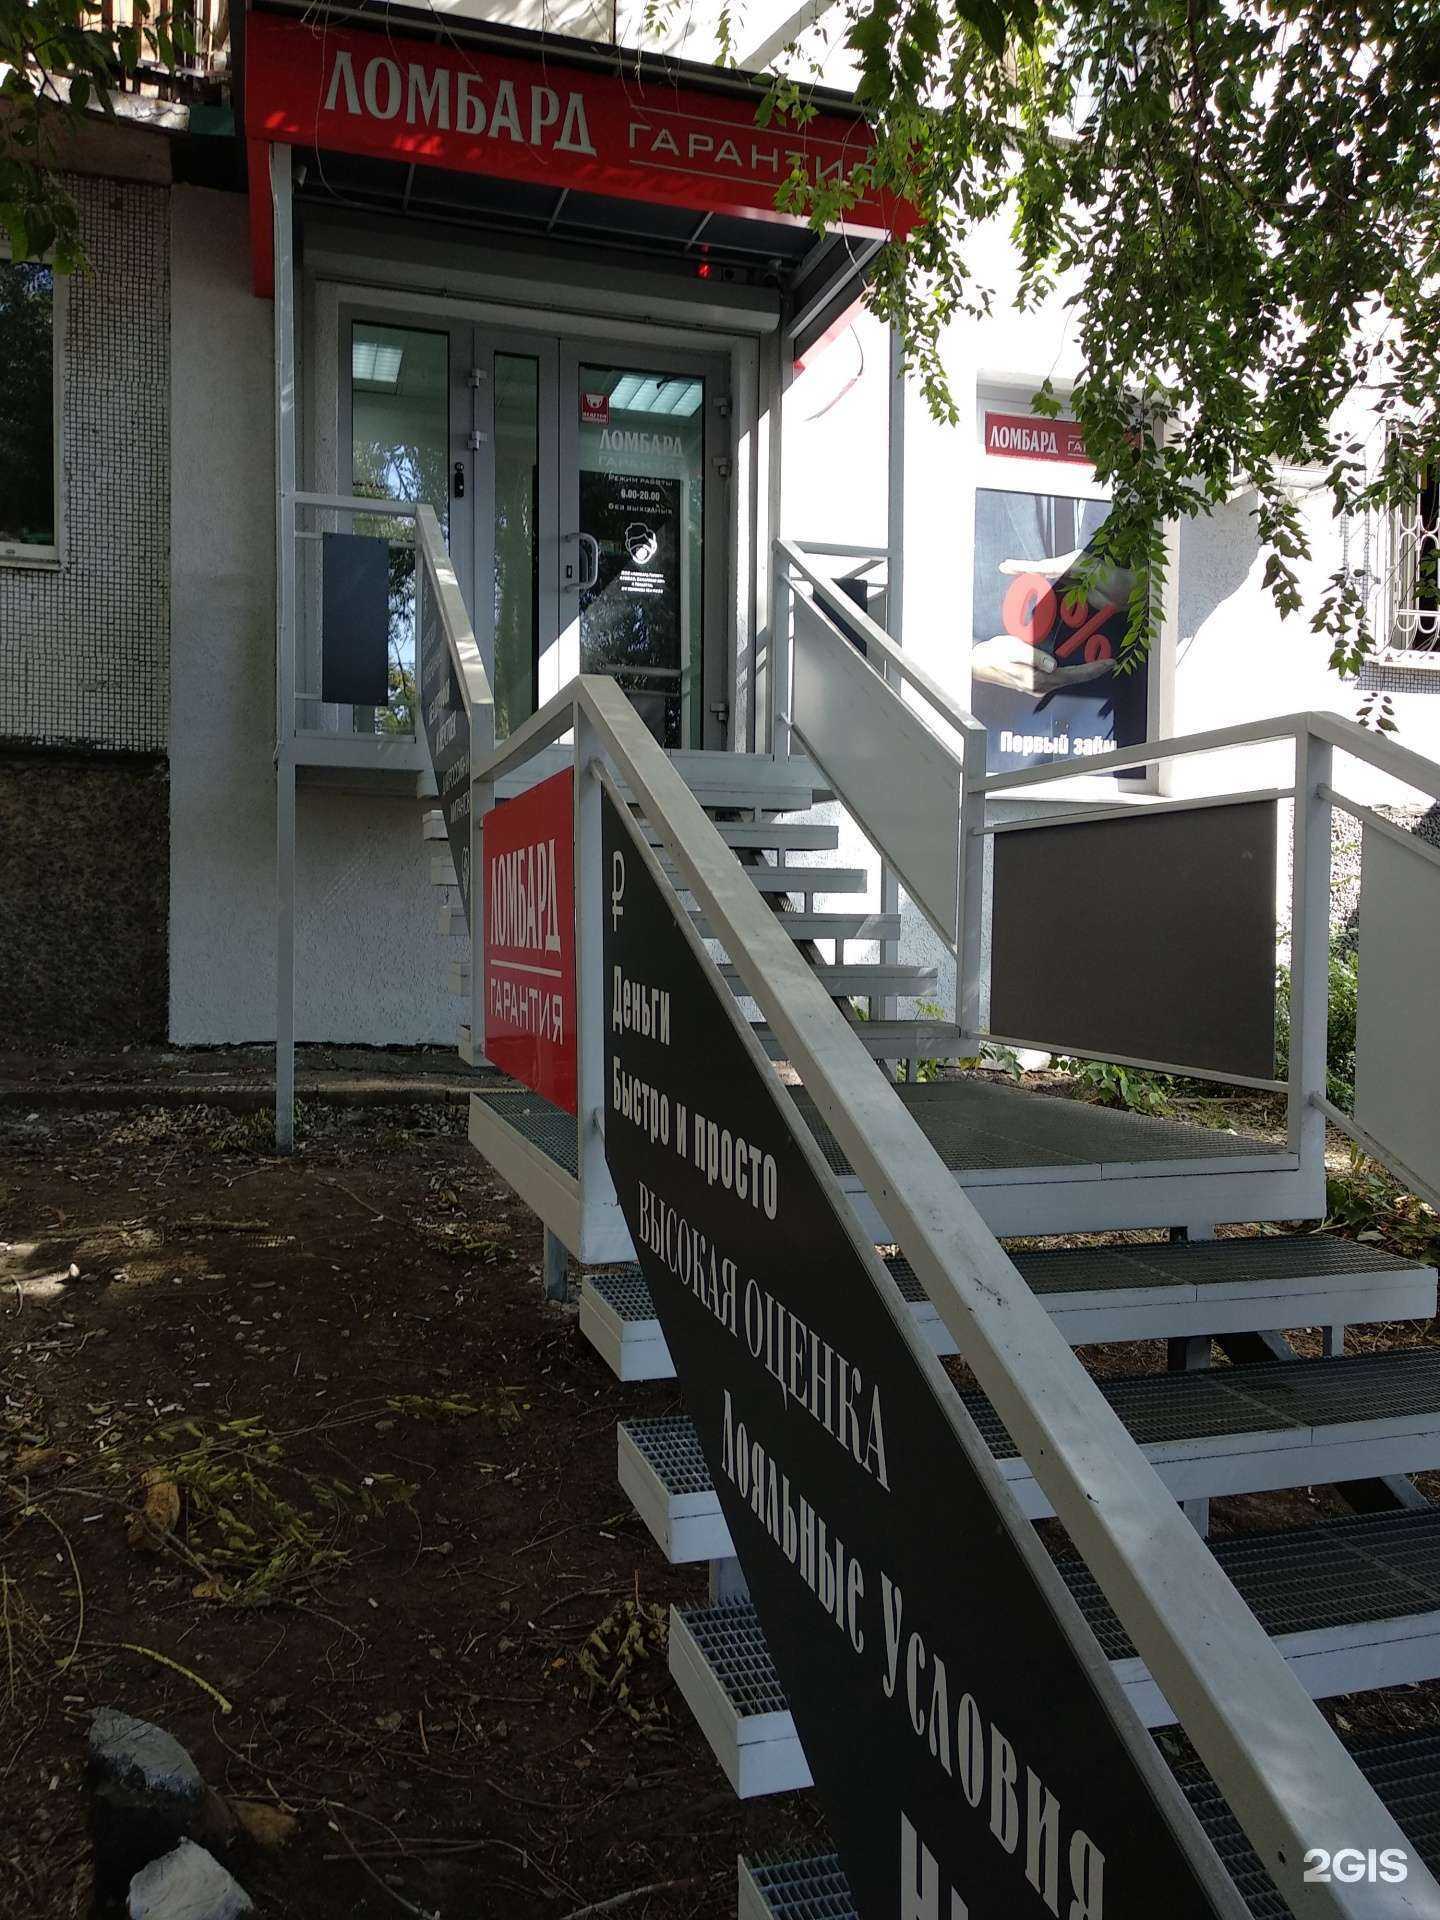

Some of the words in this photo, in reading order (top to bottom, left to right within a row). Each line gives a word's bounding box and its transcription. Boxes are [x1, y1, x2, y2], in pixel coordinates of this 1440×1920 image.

[324, 50, 597, 158] ЛОМБАРД
[600, 428, 685, 459] ЛОМБАРД
[989, 425, 1059, 454] ЛОМБАРД
[1000, 730, 1069, 757] Первый
[490, 838, 562, 959] ЛОМБАРД
[490, 976, 563, 1046] ГАРАНТИЯ
[612, 965, 671, 1047] Деньги
[612, 1055, 670, 1147] Быстро
[694, 1113, 778, 1221] просто
[638, 1180, 738, 1339] ВЫСОКАЯ
[744, 1278, 891, 1494] ОЦЕНКА
[721, 1388, 865, 1655] Лояльные
